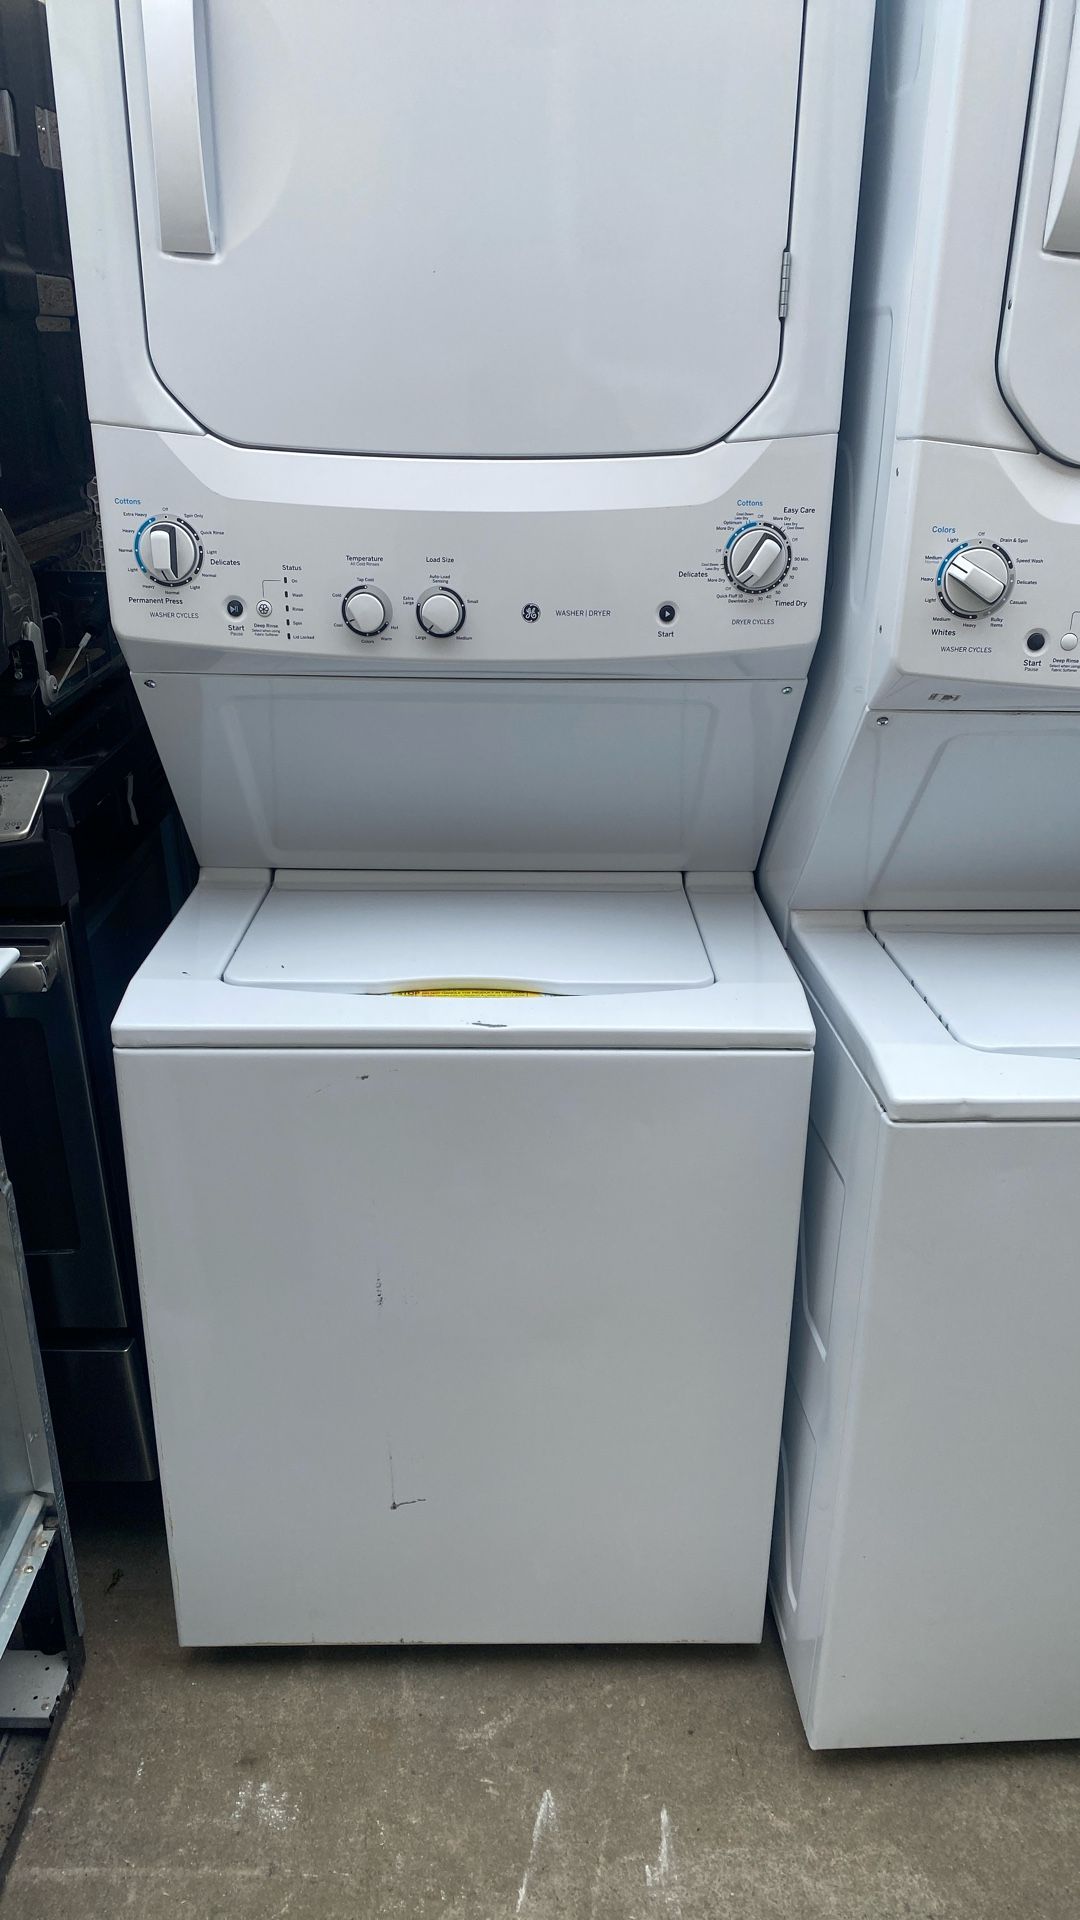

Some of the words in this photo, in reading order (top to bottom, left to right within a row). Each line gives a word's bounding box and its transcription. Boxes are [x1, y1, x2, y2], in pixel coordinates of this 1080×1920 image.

[115, 497, 141, 505] Cottons
[932, 526, 956, 534] Colors
[346, 555, 383, 563] Temperature
[165, 597, 183, 605] Press
[1023, 659, 1042, 667] Start
